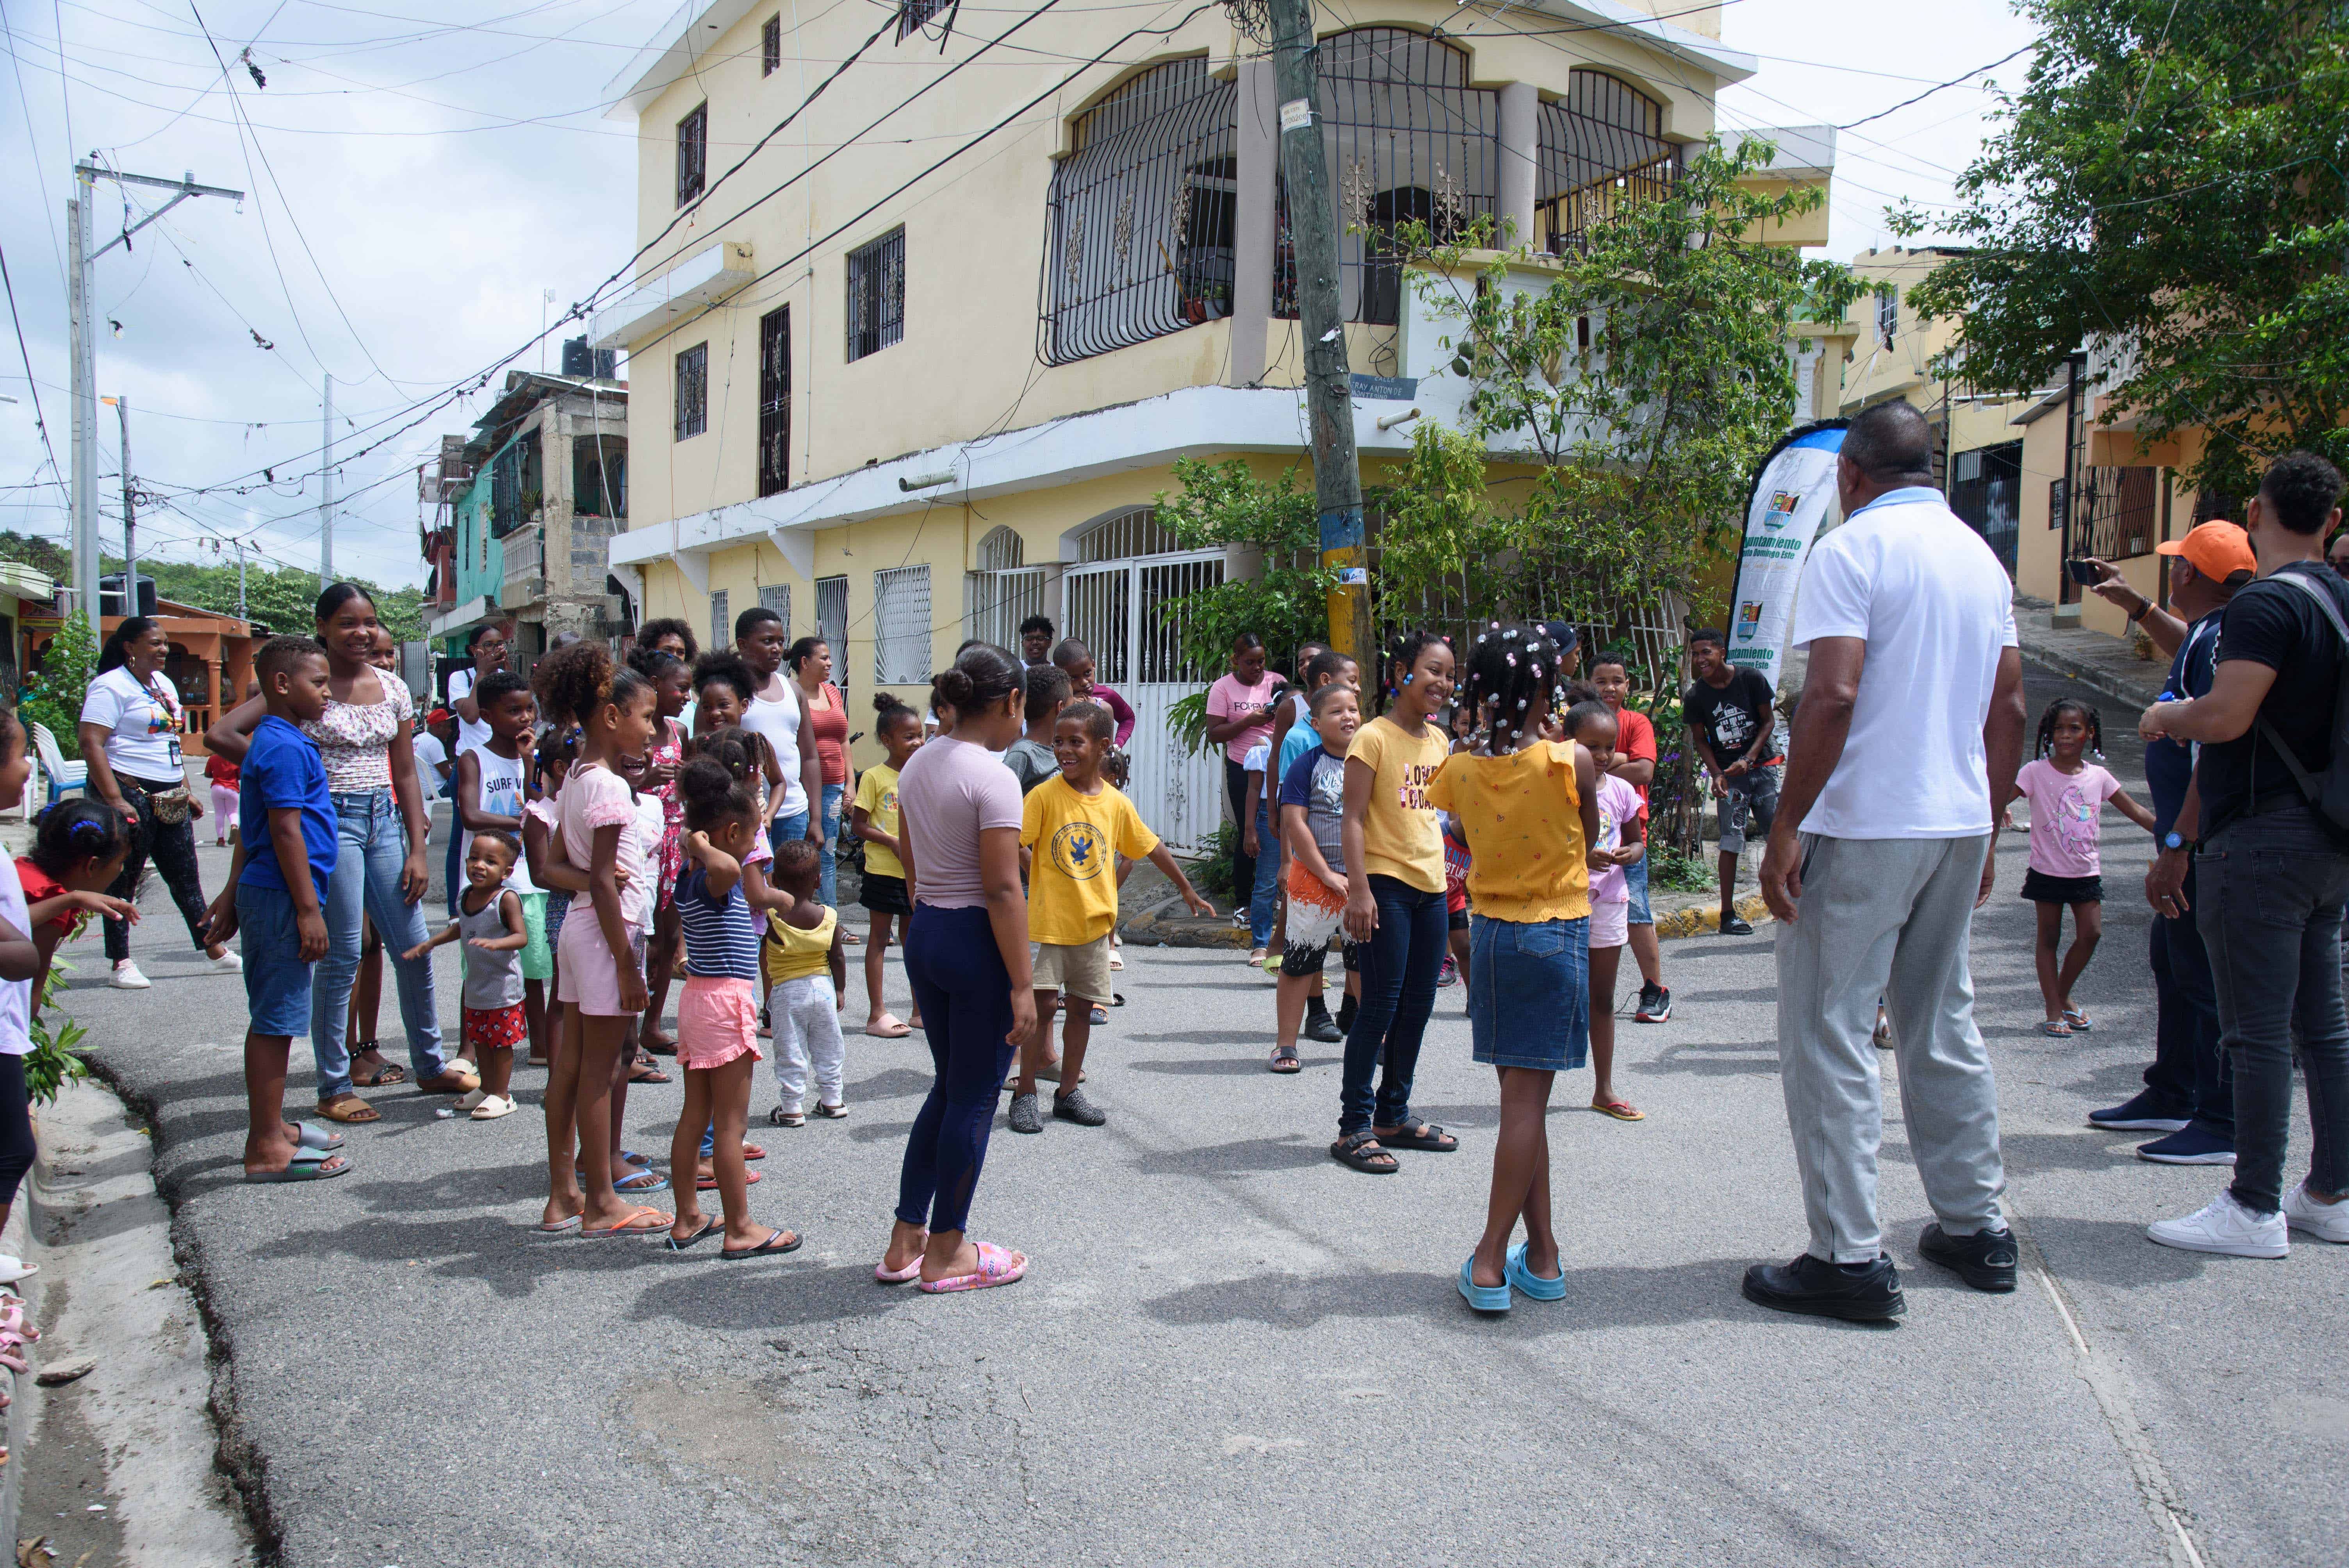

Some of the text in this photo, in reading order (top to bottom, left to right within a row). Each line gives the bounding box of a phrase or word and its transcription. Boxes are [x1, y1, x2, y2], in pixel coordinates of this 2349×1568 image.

[1369, 385, 1392, 395] ANTON
[1393, 388, 1403, 396] DE
[1753, 549, 1780, 558] Domingo
[1780, 551, 1795, 559] Este
[1755, 661, 1769, 669] Este
[486, 777, 512, 793] SURF
[1445, 861, 1456, 875] ST
